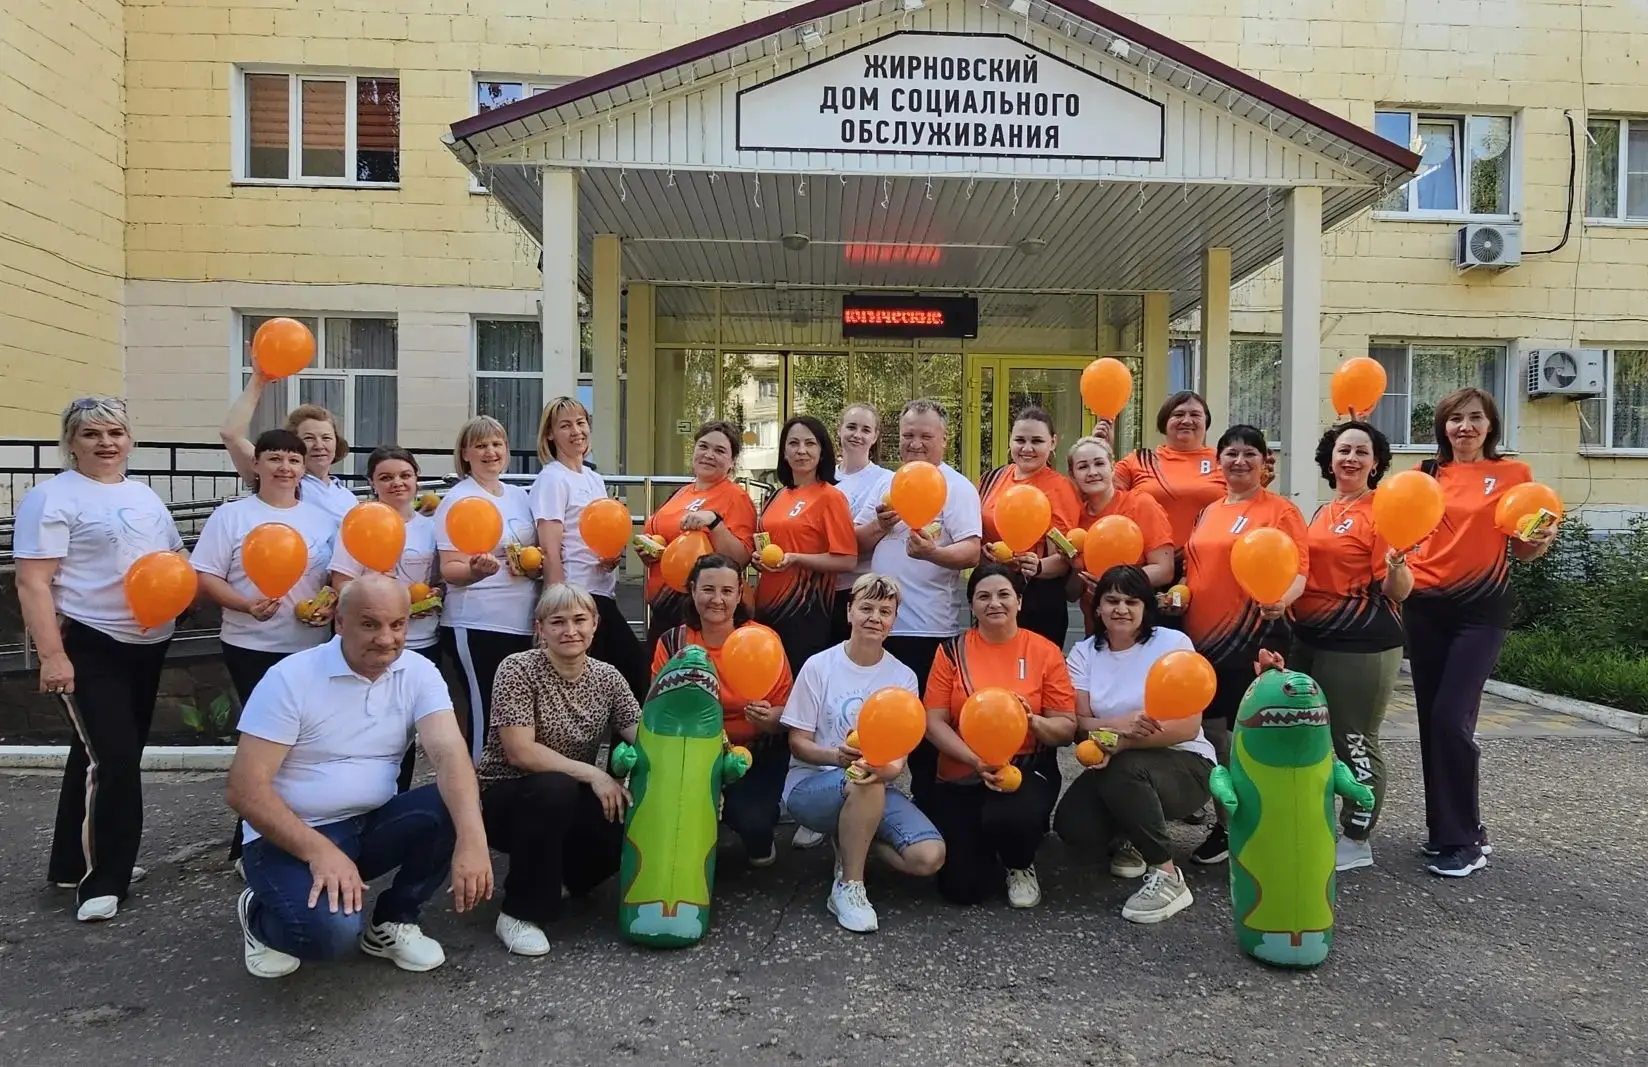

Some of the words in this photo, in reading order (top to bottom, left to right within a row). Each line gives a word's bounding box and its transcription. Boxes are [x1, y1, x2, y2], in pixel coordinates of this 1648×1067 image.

[864, 54, 1037, 84] ЖИРНОВСКИЙ
[820, 86, 878, 113] ДОМ
[891, 88, 1080, 117] СОЦИАЛЬНОГО
[841, 119, 1059, 149] ОБСЛУЖИВАНИЯ
[1200, 460, 1211, 474] 8
[1483, 476, 1497, 495] 7
[789, 500, 806, 517] 5
[1230, 515, 1248, 534] 11
[1334, 518, 1354, 534] 2
[1018, 658, 1025, 680] 1
